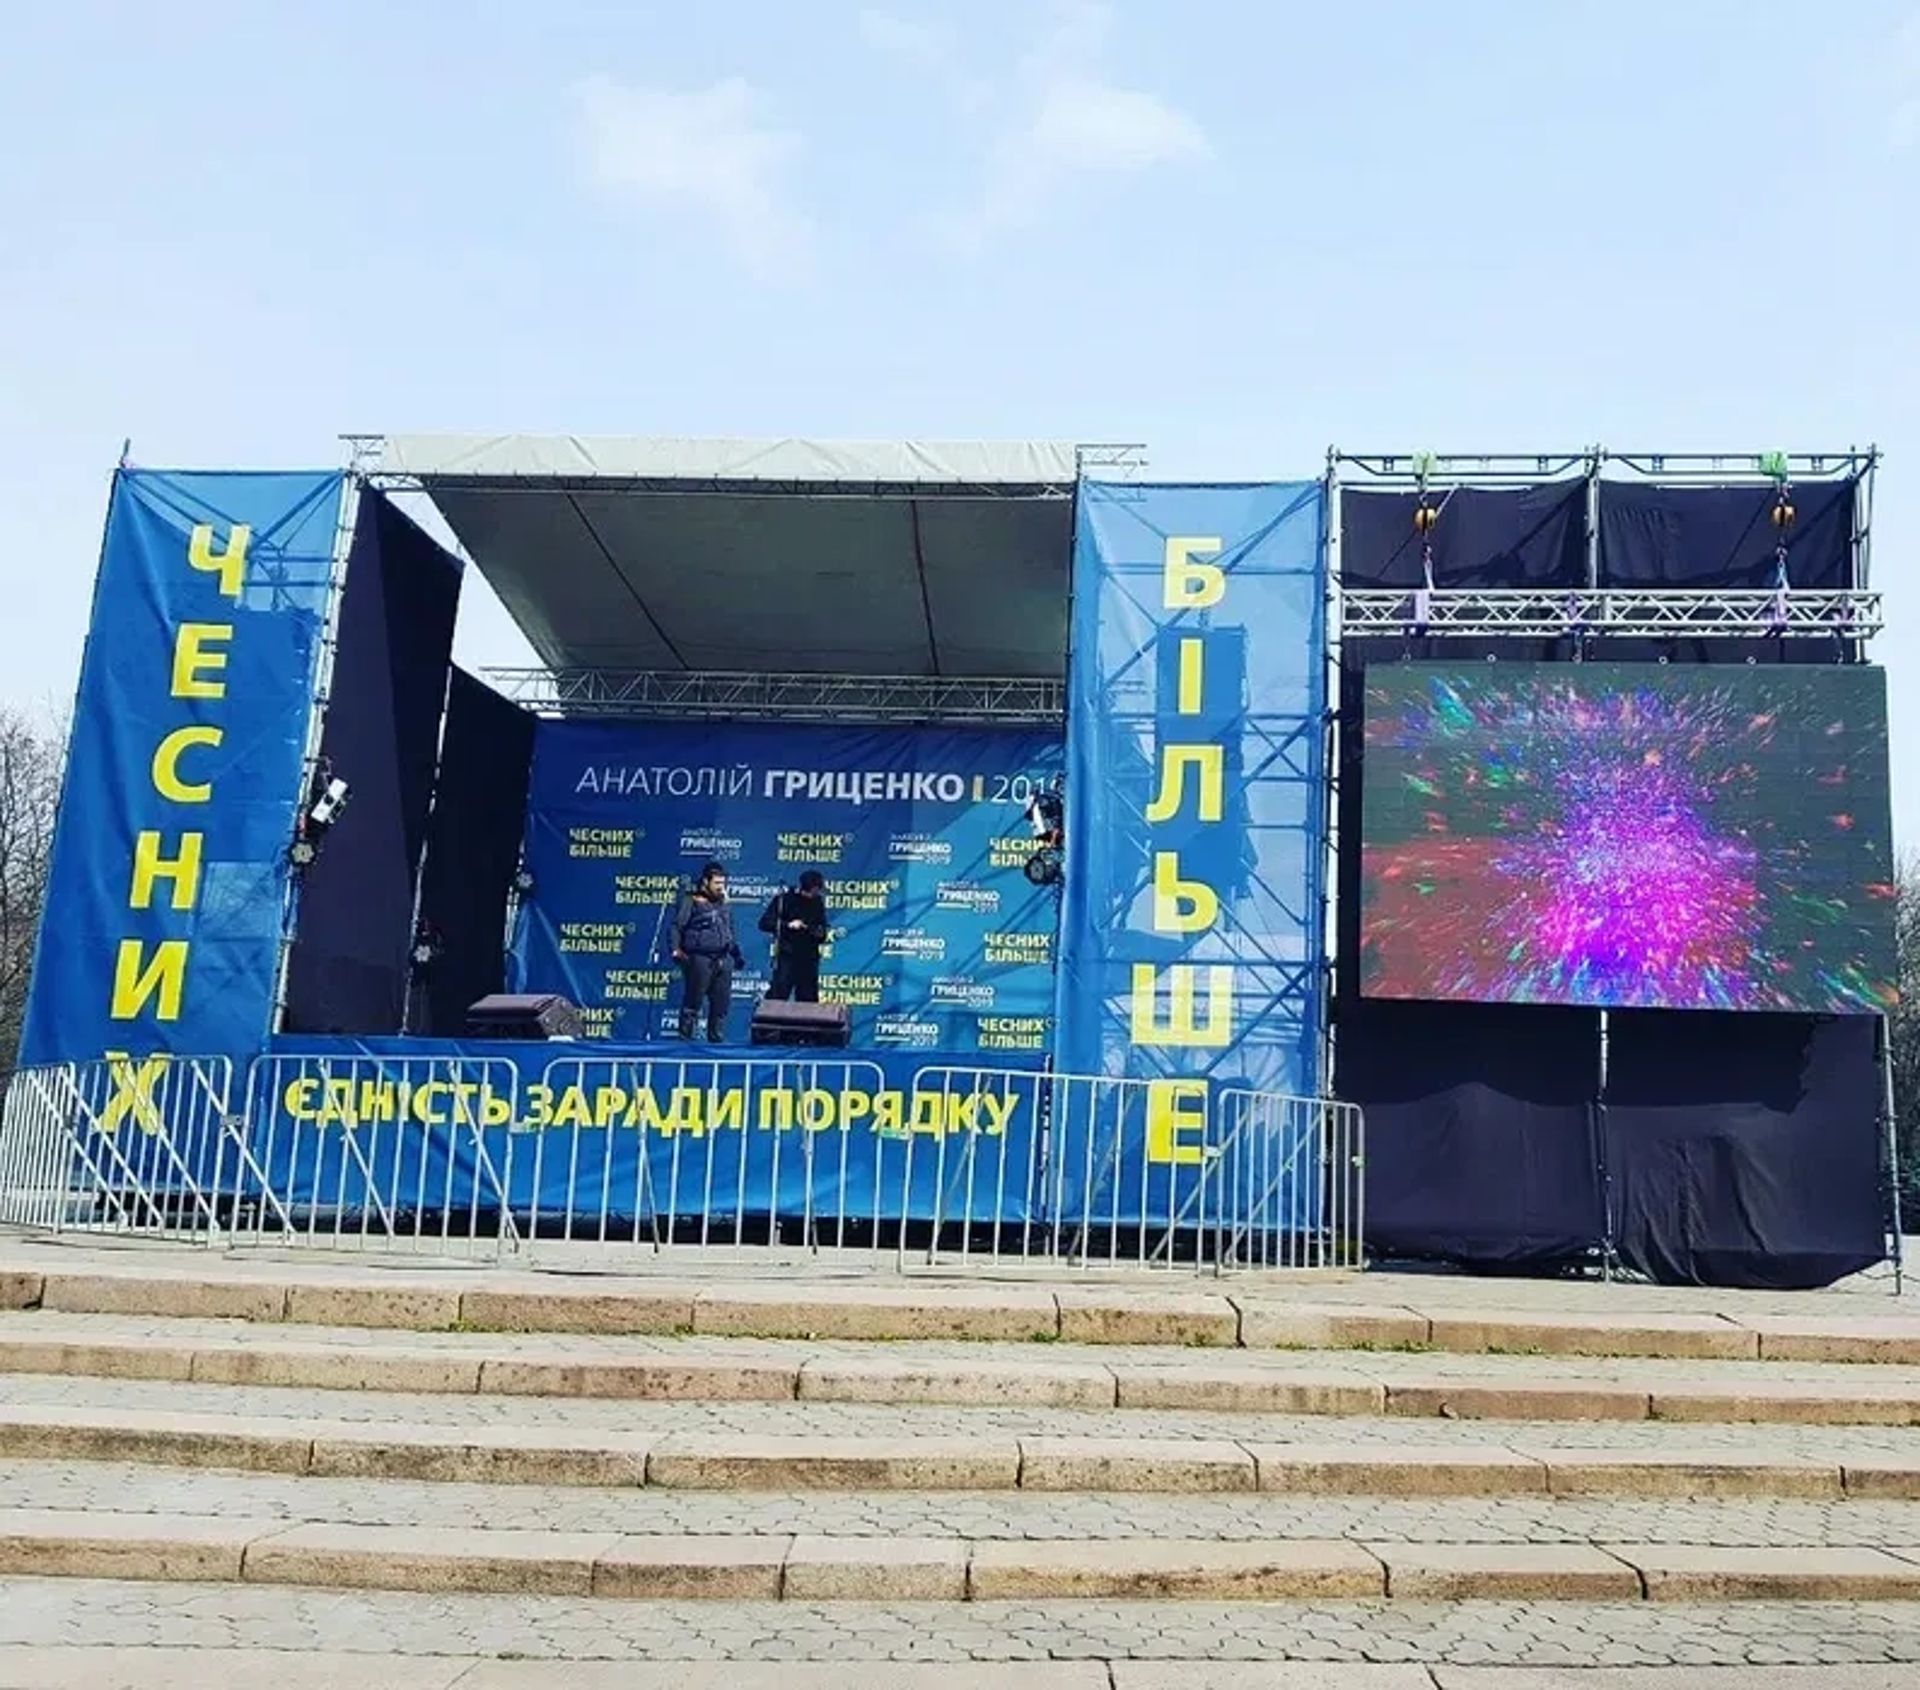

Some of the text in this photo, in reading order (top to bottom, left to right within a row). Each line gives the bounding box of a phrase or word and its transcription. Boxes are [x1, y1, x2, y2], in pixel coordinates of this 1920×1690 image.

[575, 763, 752, 796] АНАТОЛІЙ
[763, 769, 965, 804] ГРИЦЕНКО
[97, 523, 251, 1137] ЧЕСНИХ
[569, 828, 634, 843] ЧЕСНИХ
[777, 833, 843, 848] ЧЕСНИХ
[569, 844, 632, 858] БІЛЬШЕ
[777, 849, 841, 862] БІЛЬШЕ
[1130, 536, 1227, 1166] БІЛЬШЕ
[615, 875, 680, 889] ЧЕСНИХ
[824, 880, 890, 894] ЧЕСНИХ
[825, 895, 887, 909] БІЛЬШЕ
[560, 924, 625, 938] ЧЕСНИХ
[559, 938, 623, 952] БІЛЬШЕ
[984, 933, 1050, 948] ЧЕСНИХ
[984, 949, 1048, 963] БІЛЬШЕ
[605, 970, 670, 984] ЧЕСНИХ
[818, 974, 882, 989] ЧЕСНИХ
[605, 985, 668, 1000] БІЛЬШЕ
[818, 990, 881, 1004] БІЛЬШЕ
[977, 1017, 1044, 1033] ЧЕСНИХ
[978, 1034, 1043, 1048] БІЛЬШЕ
[284, 1078, 1019, 1142] ЄДНІСТЬ ЗАРАДИ ПОРЯДКУ
